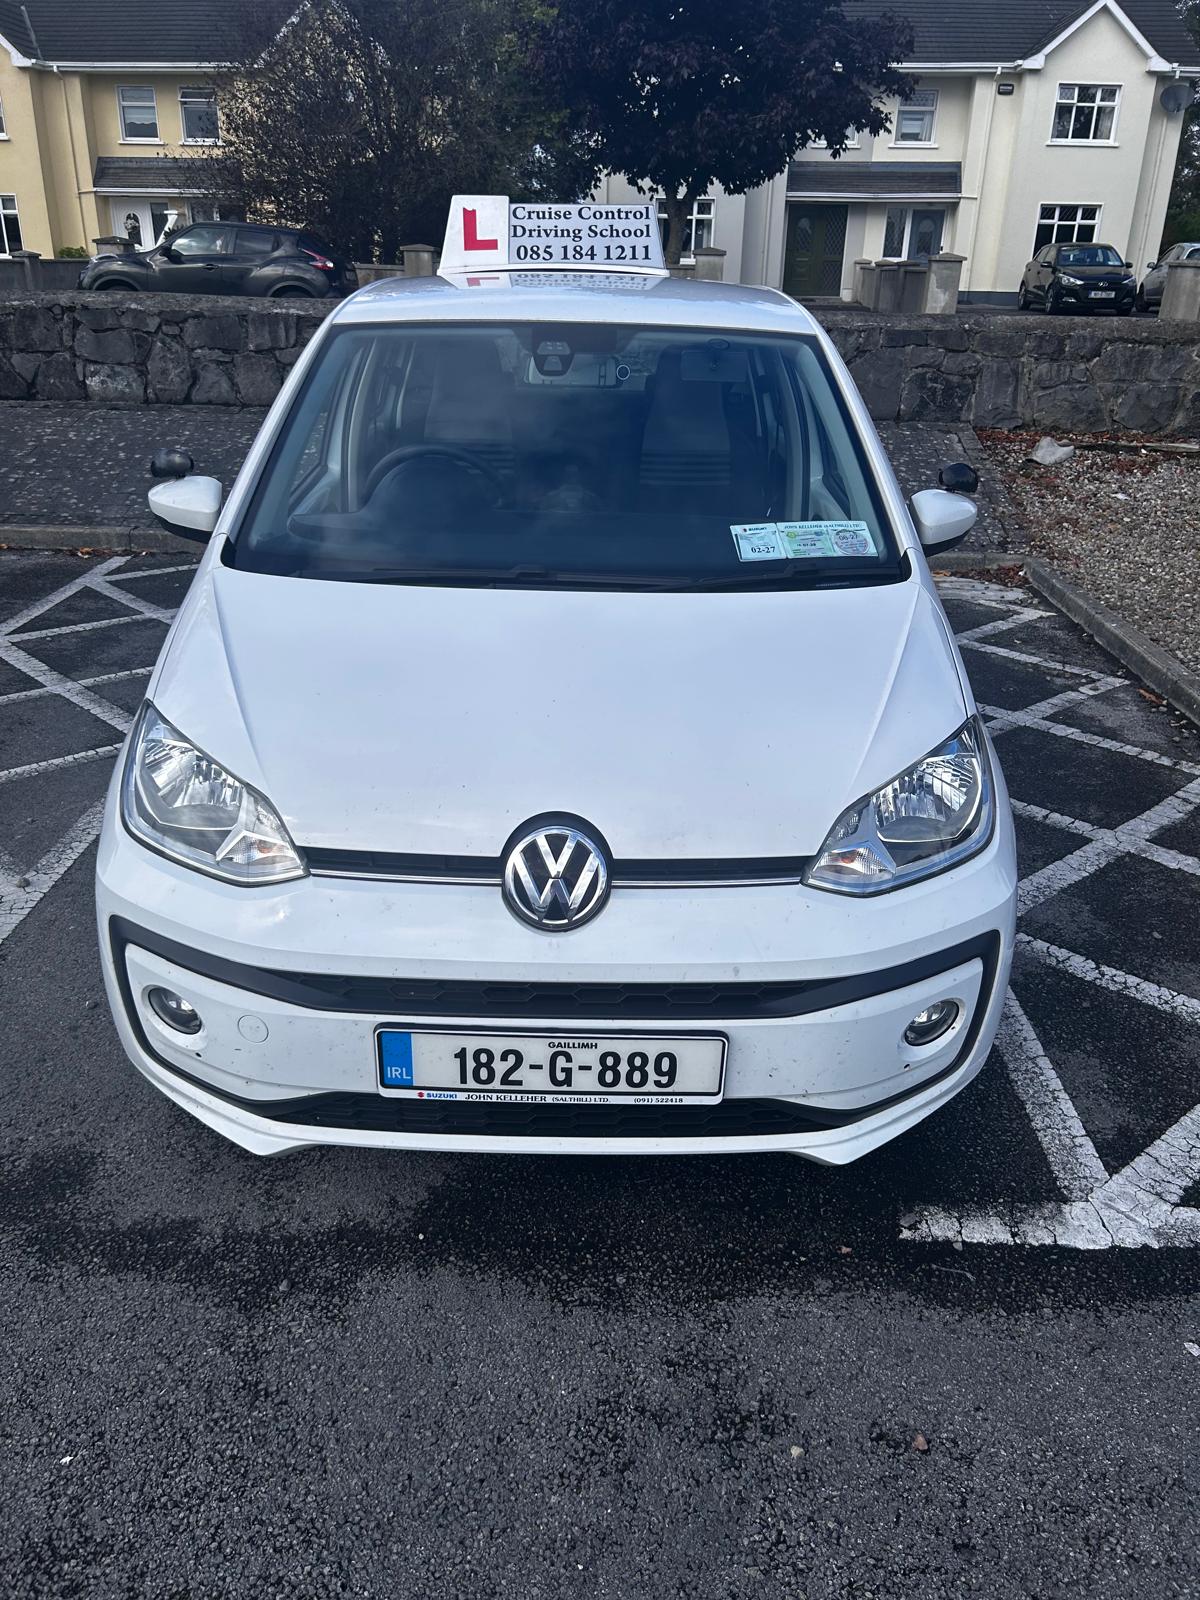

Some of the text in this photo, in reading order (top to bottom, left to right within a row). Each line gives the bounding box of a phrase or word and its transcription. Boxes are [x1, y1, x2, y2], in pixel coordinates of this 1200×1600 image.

[511, 205, 651, 221] Cruise Control
[462, 206, 499, 252] L
[511, 223, 652, 242] Driving School
[516, 243, 652, 262] 085 184 1211
[750, 546, 776, 554] 02-27
[547, 1041, 599, 1050] GAILLIMH
[386, 1066, 412, 1080] IRL
[453, 1046, 679, 1089] 182-G-889
[426, 1092, 458, 1100] SUZUKI
[464, 1093, 494, 1101] JOHN
[495, 1094, 547, 1102] KELLEHER
